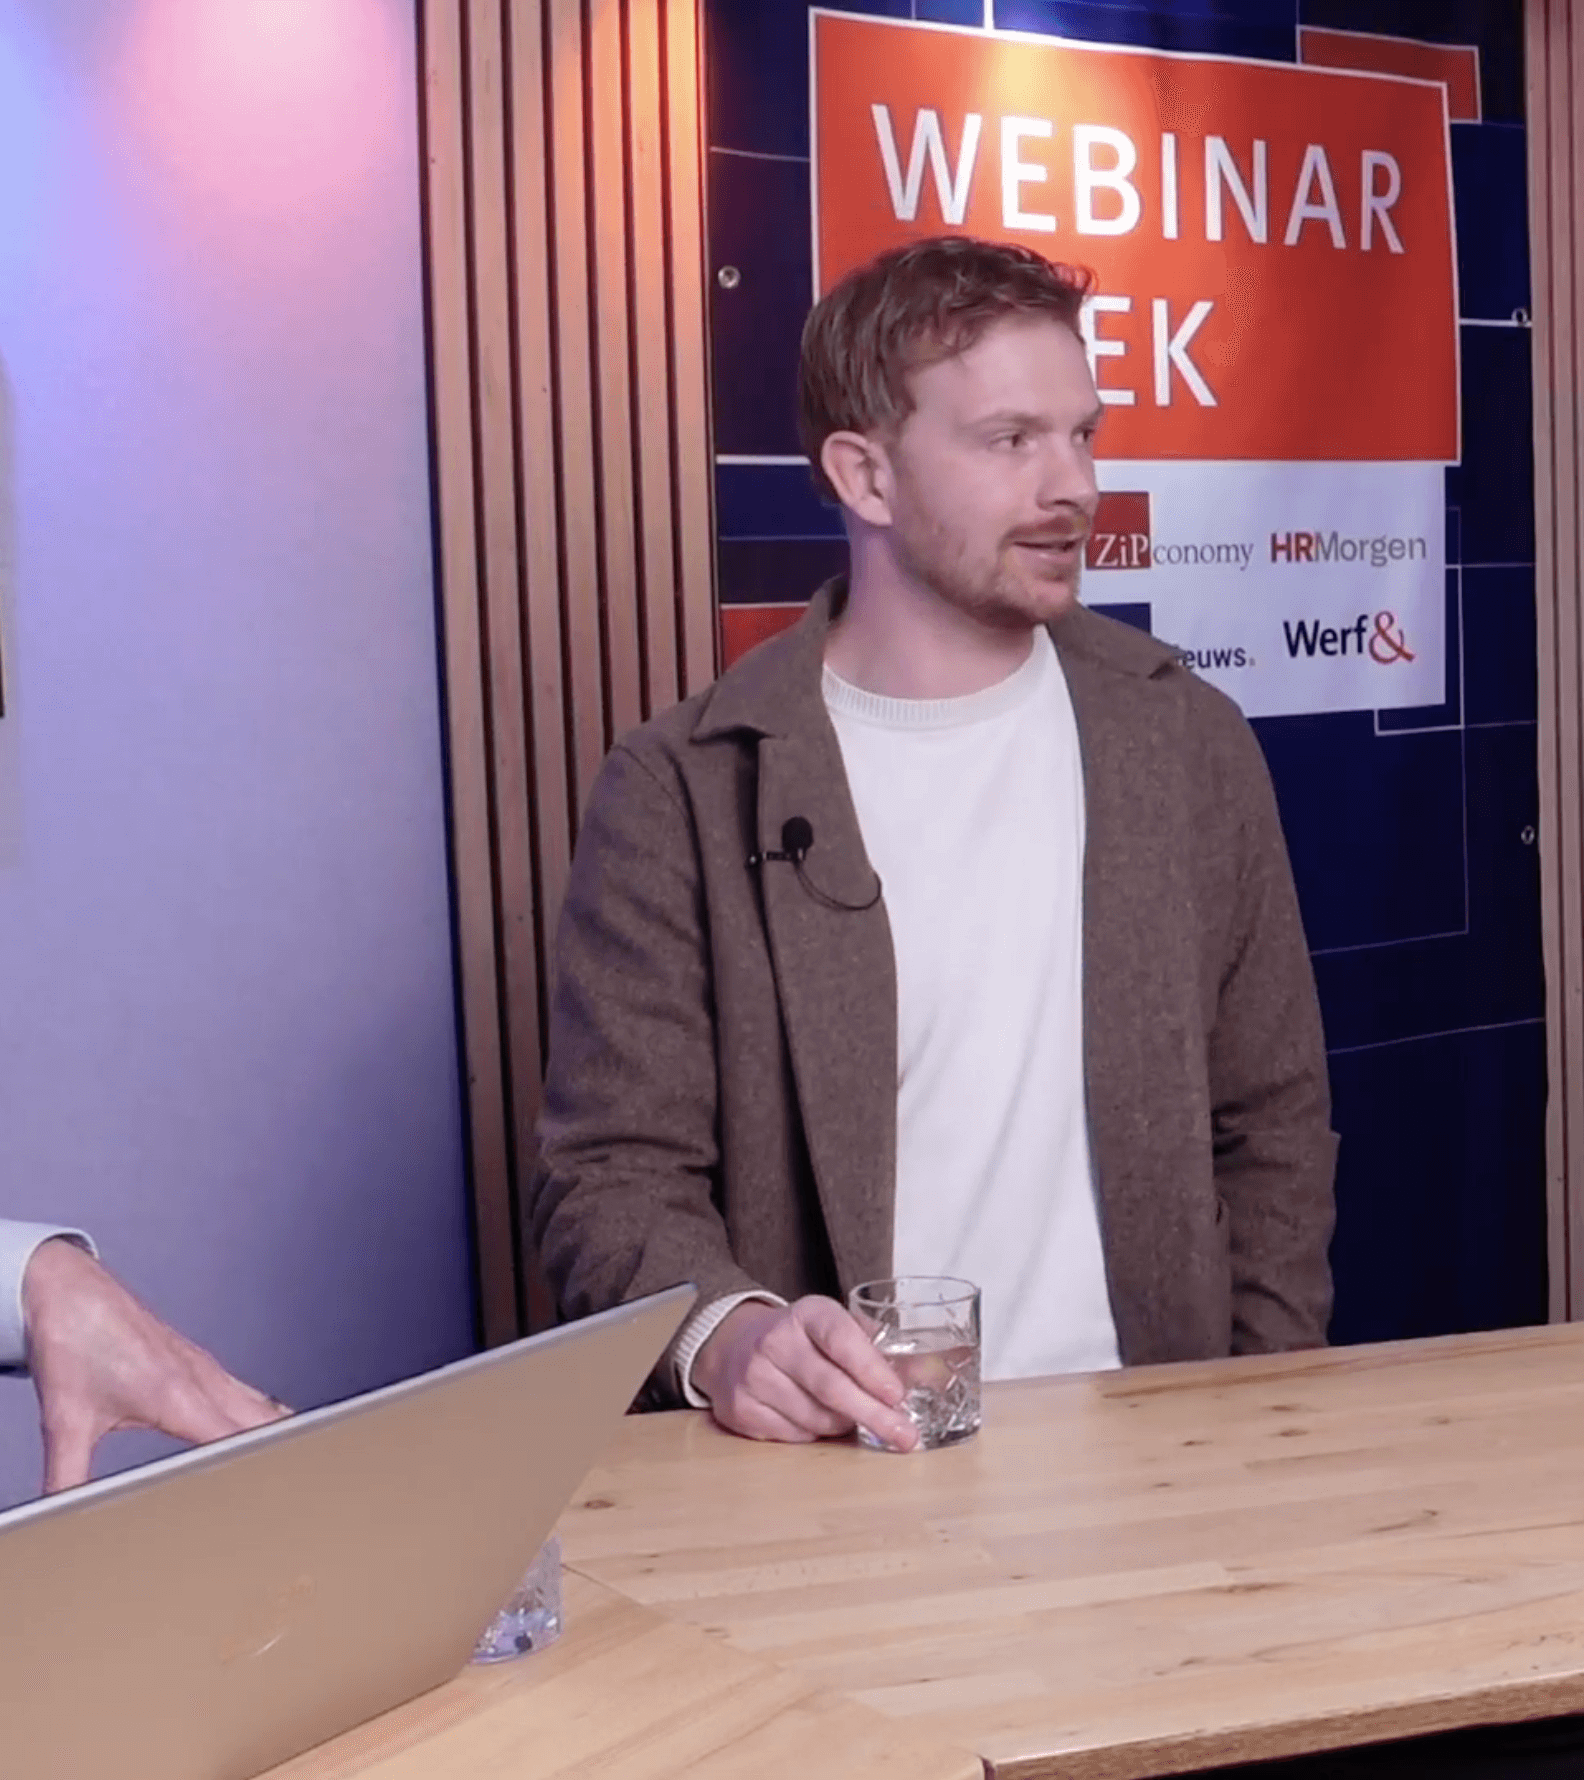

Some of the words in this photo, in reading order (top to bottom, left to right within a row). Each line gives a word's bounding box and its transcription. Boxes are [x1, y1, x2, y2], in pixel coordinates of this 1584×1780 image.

[871, 103, 1405, 254] WEBINAR
[1082, 295, 1218, 407] EK
[1094, 532, 1254, 571] ZiPconomy
[1270, 532, 1427, 567] HRMorgen
[1283, 611, 1416, 664] Werf&
